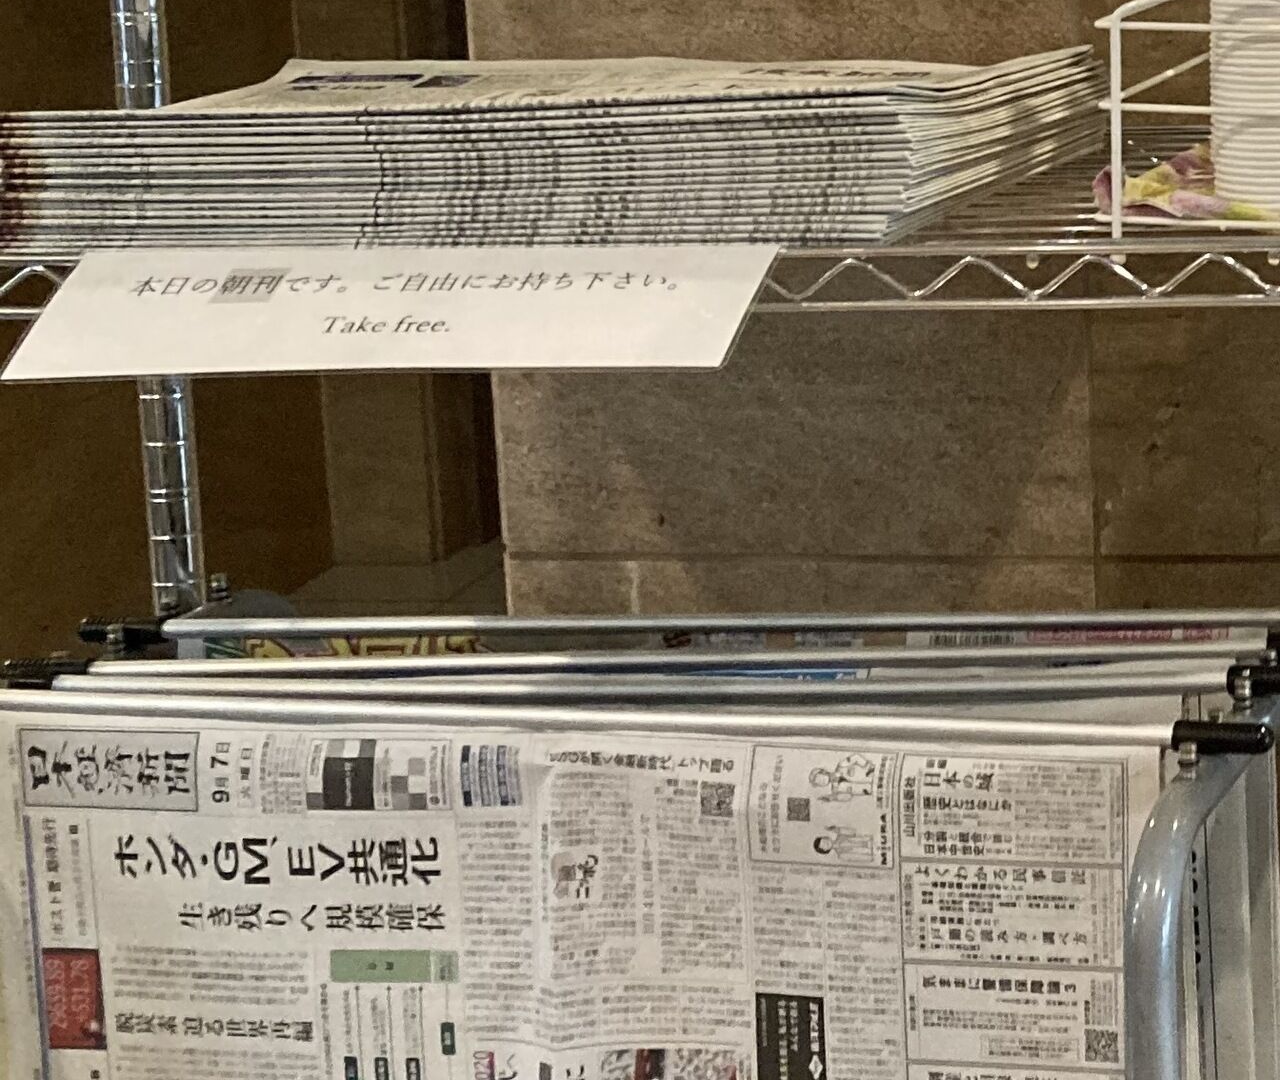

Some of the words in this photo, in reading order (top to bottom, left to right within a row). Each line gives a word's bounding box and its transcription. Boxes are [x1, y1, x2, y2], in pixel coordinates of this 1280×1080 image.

[321, 316, 388, 335] Take
[394, 315, 451, 333] free.
[115, 834, 444, 886] ホンダ・GM、EV共通化
[179, 901, 446, 932] 生き残りへ規模確保
